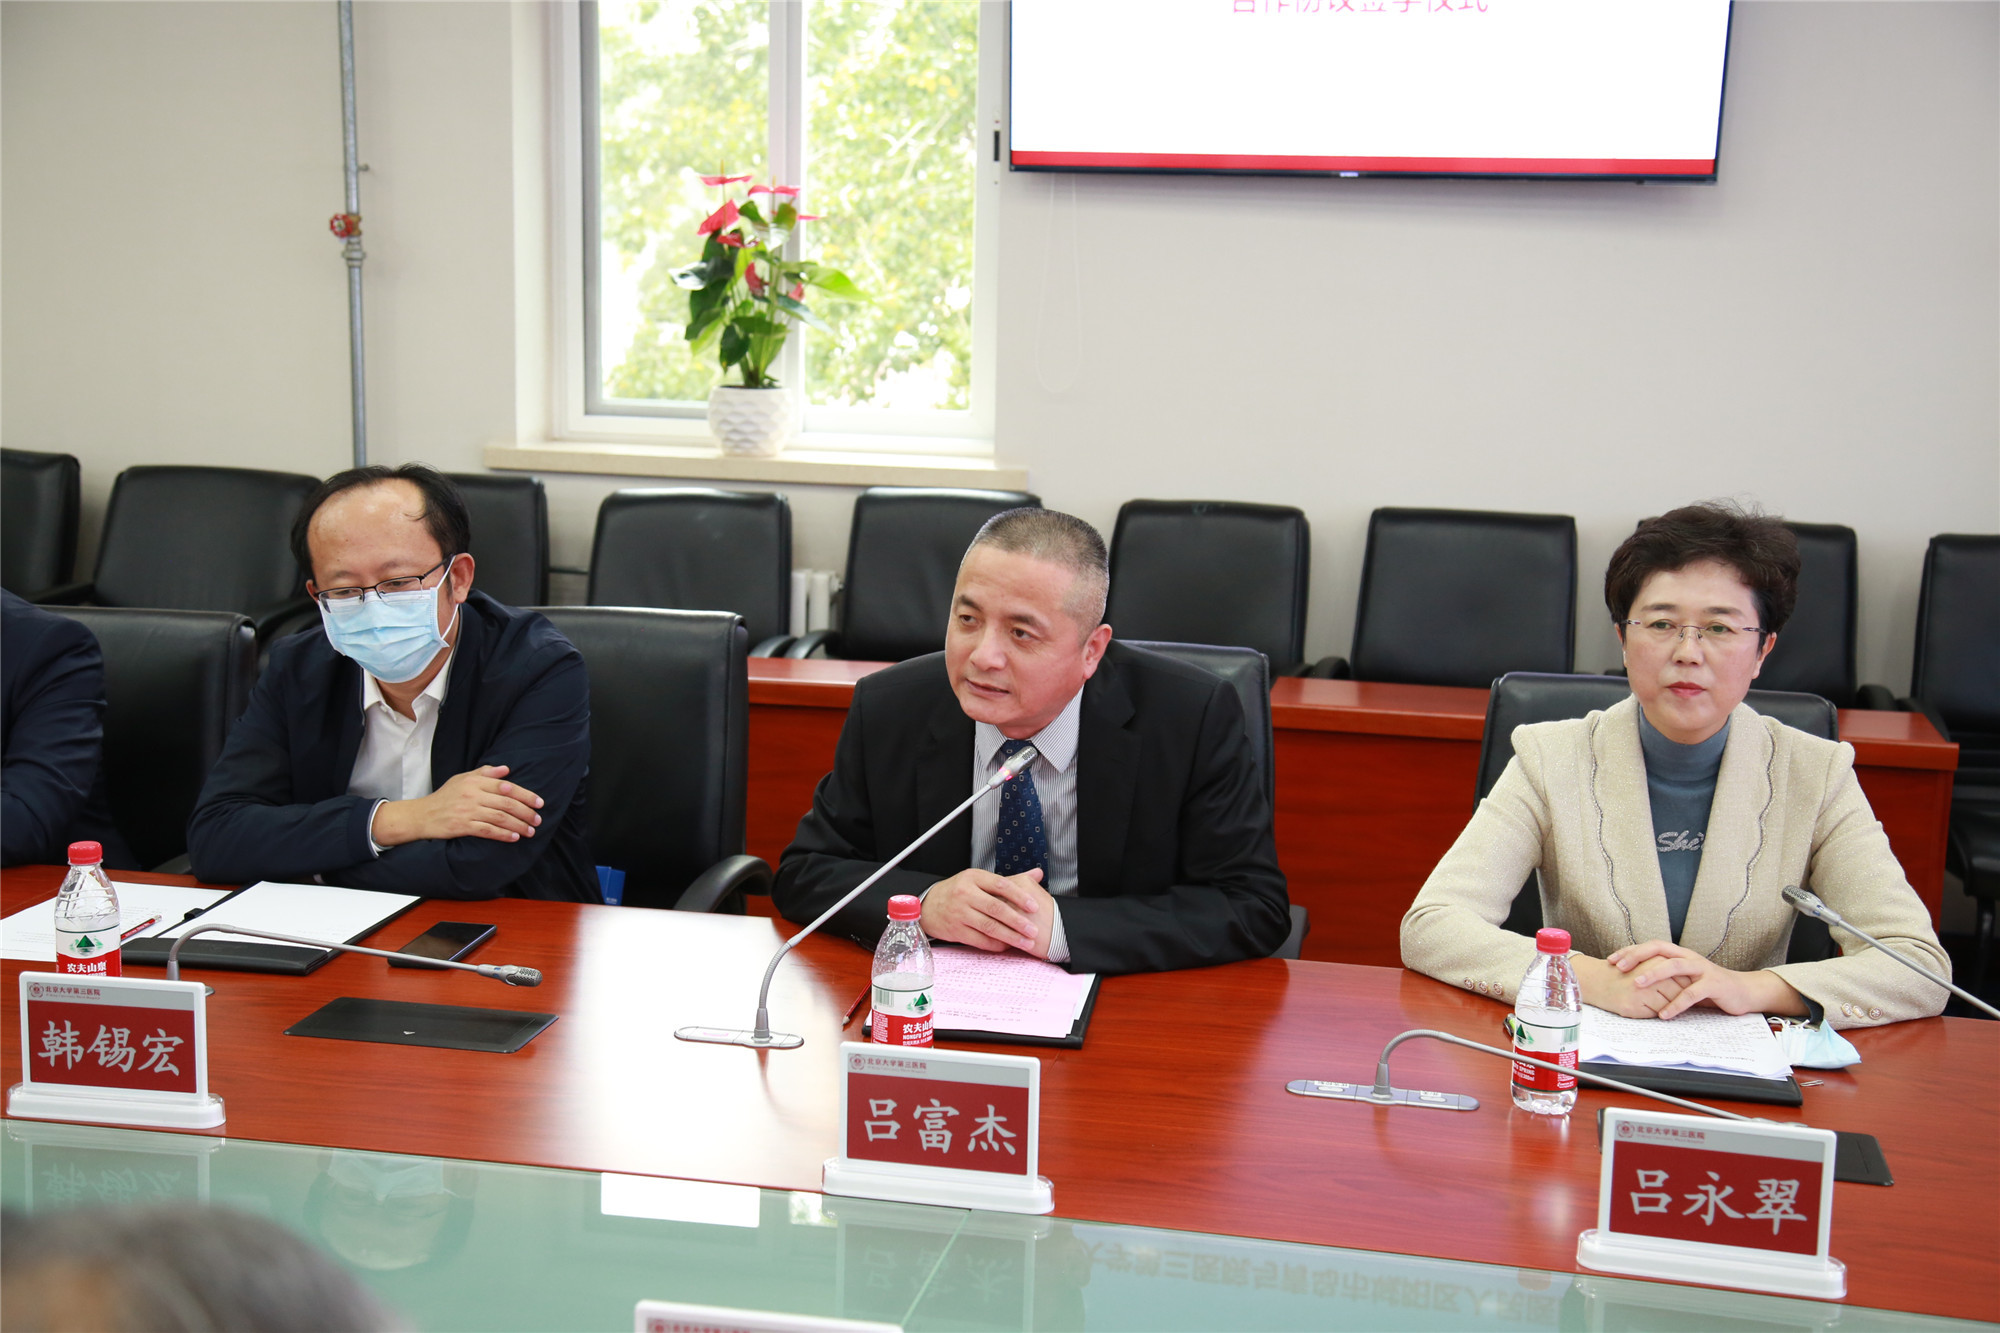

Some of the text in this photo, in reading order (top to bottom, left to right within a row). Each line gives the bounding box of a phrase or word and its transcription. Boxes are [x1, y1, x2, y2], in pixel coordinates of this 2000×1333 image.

[67, 961, 107, 973] 农夫山泉
[45, 986, 101, 996] 北京大学第三医院
[37, 1019, 184, 1077] 韩锡宏
[867, 1058, 927, 1070] 北京大学第三医院
[864, 1098, 1017, 1155] 吕富杰
[1638, 1126, 1705, 1140] 北京大学第三医院
[1630, 1169, 1808, 1236] 吕永翠
